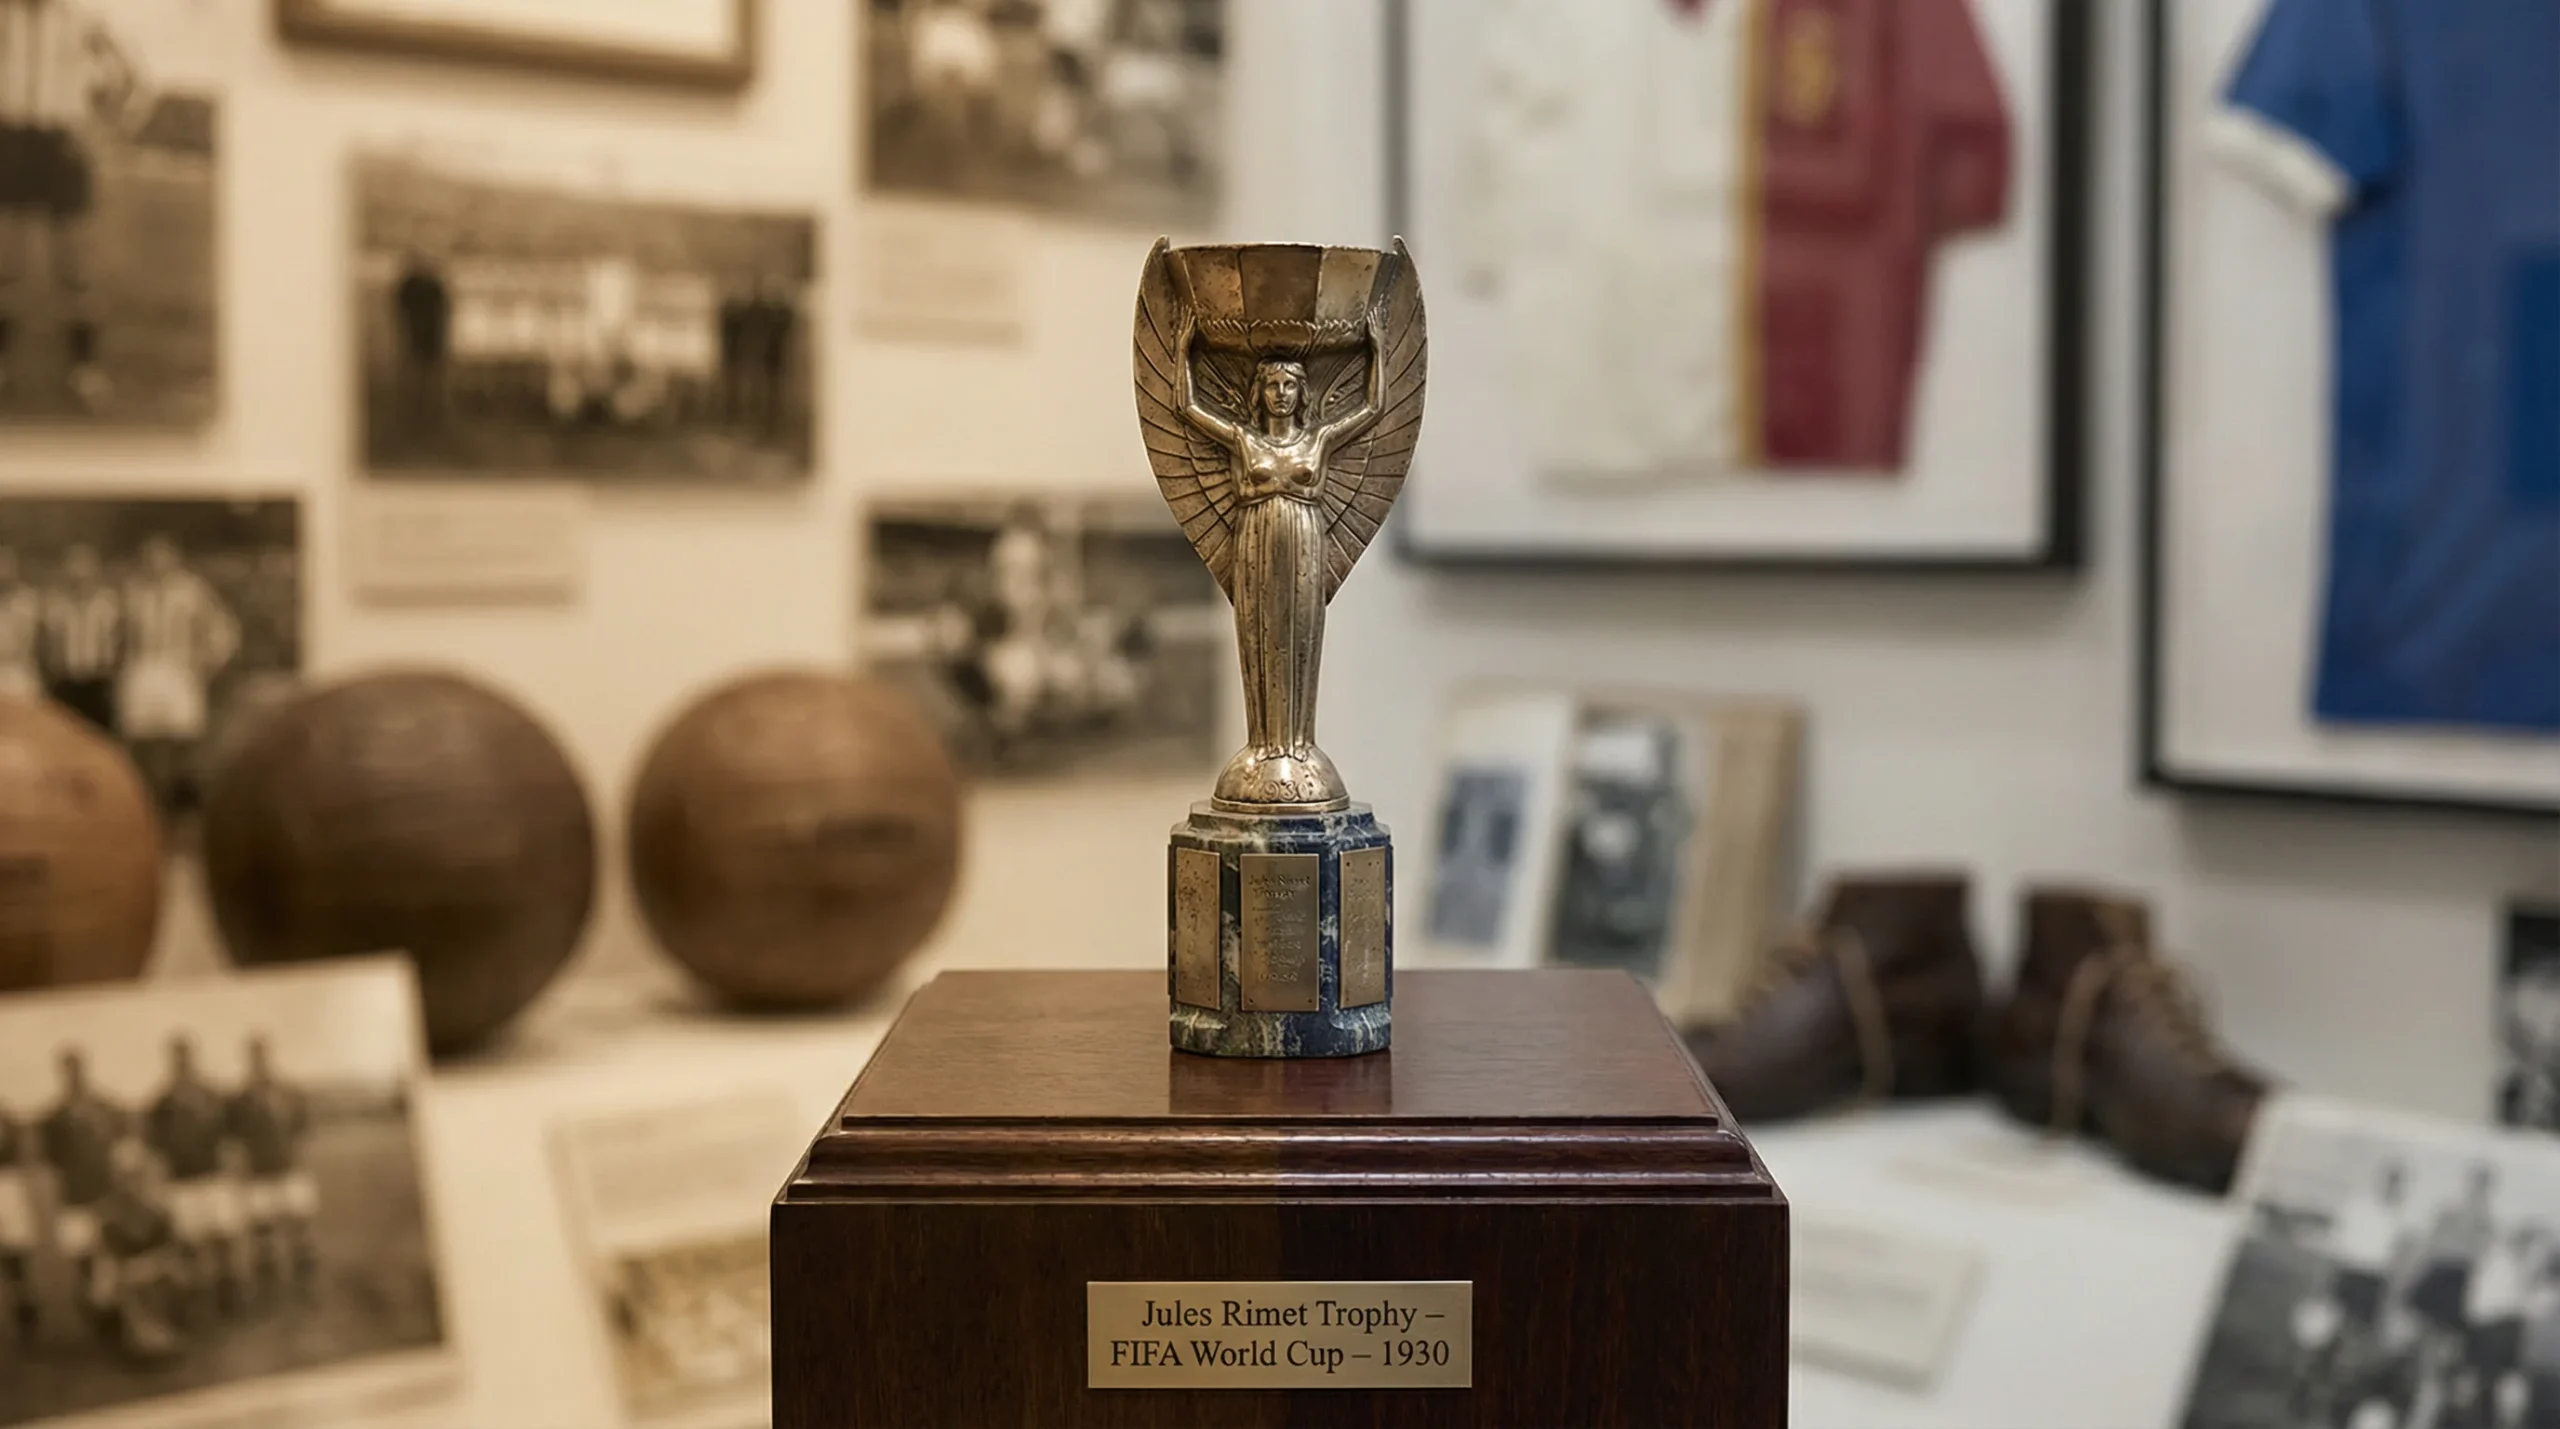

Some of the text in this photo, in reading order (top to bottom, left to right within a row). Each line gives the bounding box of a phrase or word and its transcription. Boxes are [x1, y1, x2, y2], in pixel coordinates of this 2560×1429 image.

[1141, 1299, 1213, 1327] Jules
[1221, 1299, 1308, 1327] Rimet
[1315, 1299, 1418, 1334] Trophy
[1110, 1340, 1183, 1367] FIFA
[1190, 1339, 1278, 1367] World
[1286, 1340, 1344, 1374] Cup
[1382, 1340, 1450, 1367] 1930
